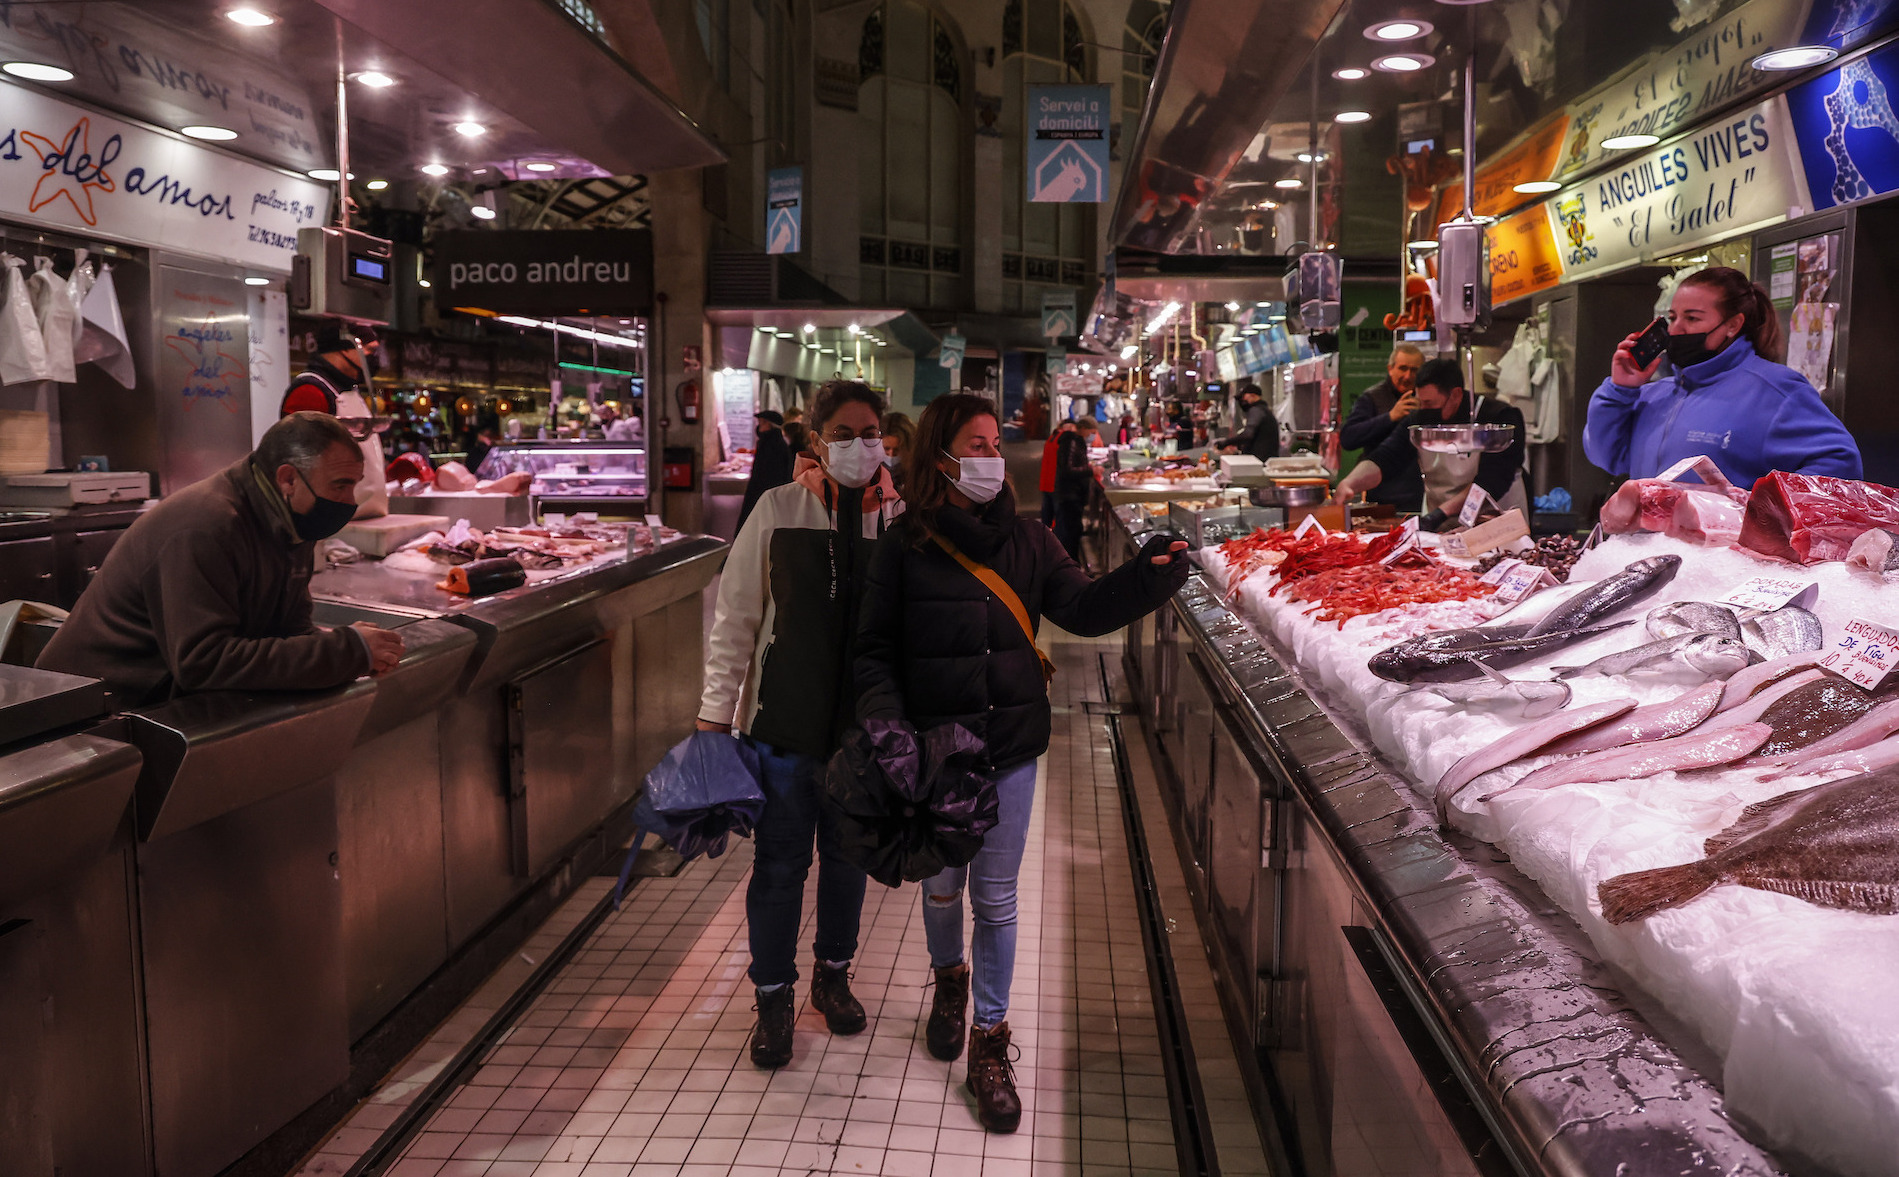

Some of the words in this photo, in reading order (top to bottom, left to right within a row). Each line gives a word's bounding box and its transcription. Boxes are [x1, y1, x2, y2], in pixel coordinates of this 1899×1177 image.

[1039, 96, 1086, 112] Servei
[1089, 101, 1099, 112] a
[42, 126, 122, 184] del
[125, 167, 235, 220] amor
[1599, 147, 1689, 213] ANGUILES
[1693, 112, 1770, 173] VIVES
[450, 262, 517, 290] paco
[526, 255, 630, 283] andreu
[1838, 636, 1859, 649] DE
[1820, 650, 1840, 667] 10
